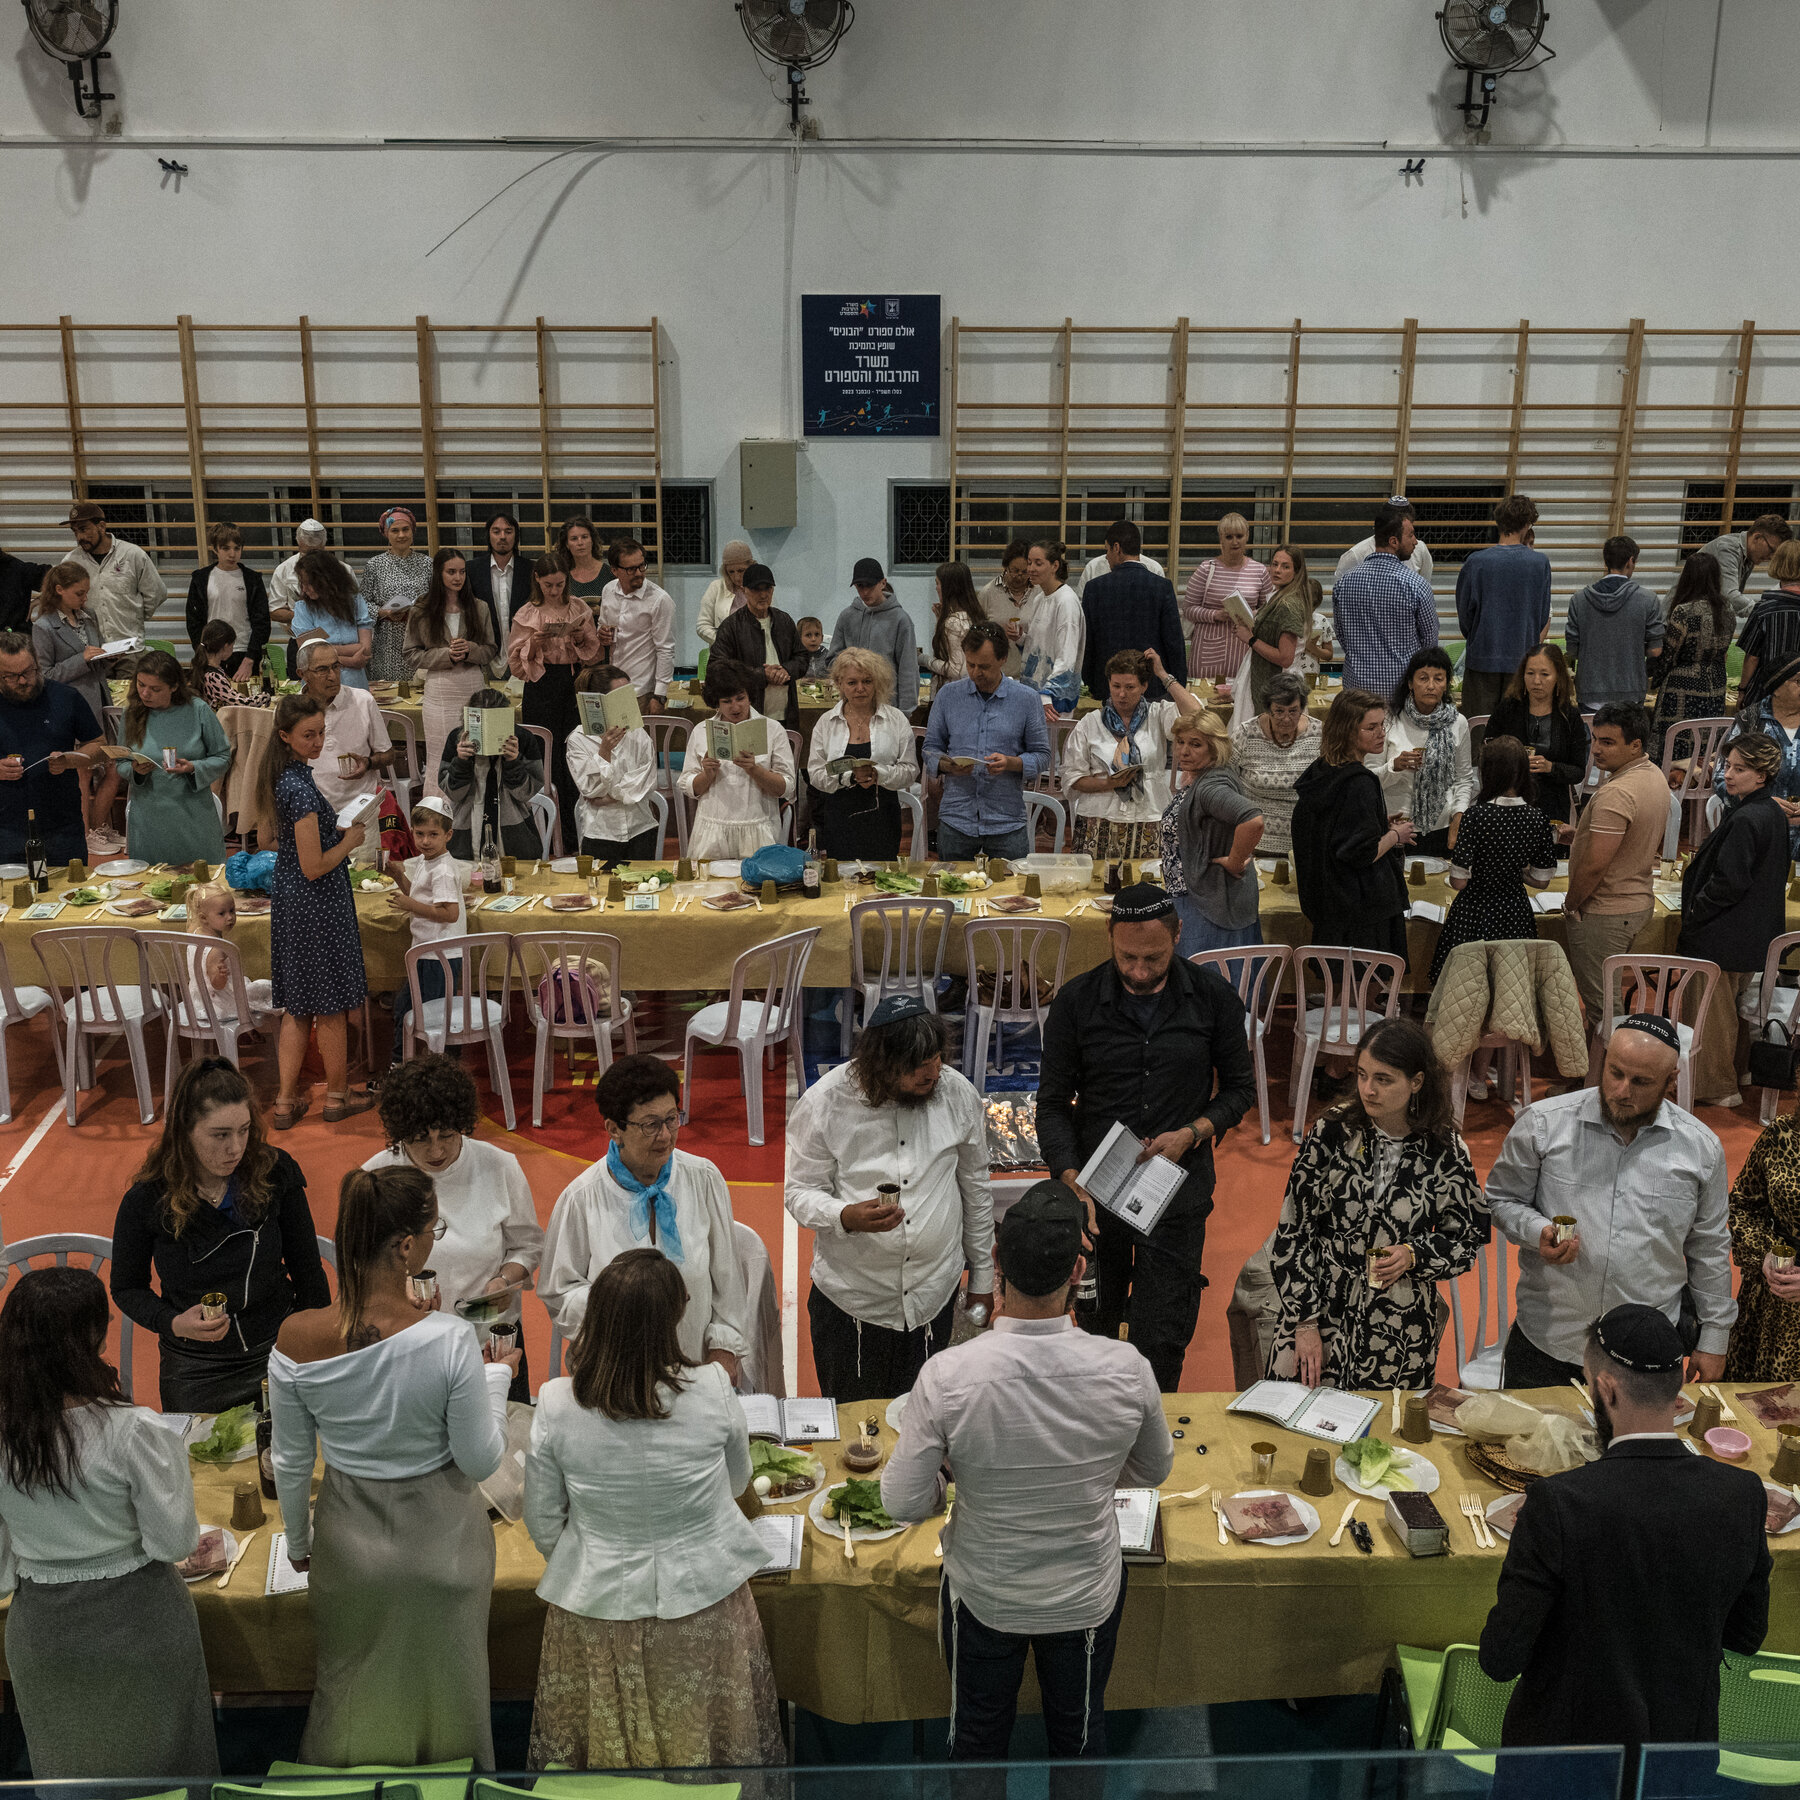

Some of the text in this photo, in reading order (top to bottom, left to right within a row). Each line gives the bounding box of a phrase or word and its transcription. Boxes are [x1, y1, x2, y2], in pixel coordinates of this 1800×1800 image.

[868, 327, 893, 336] ספורט
[895, 325, 915, 337] אולם
[848, 341, 896, 352] שופץ בתמיכת
[855, 356, 889, 367] משרד
[825, 371, 920, 383] התרבות והספורט
